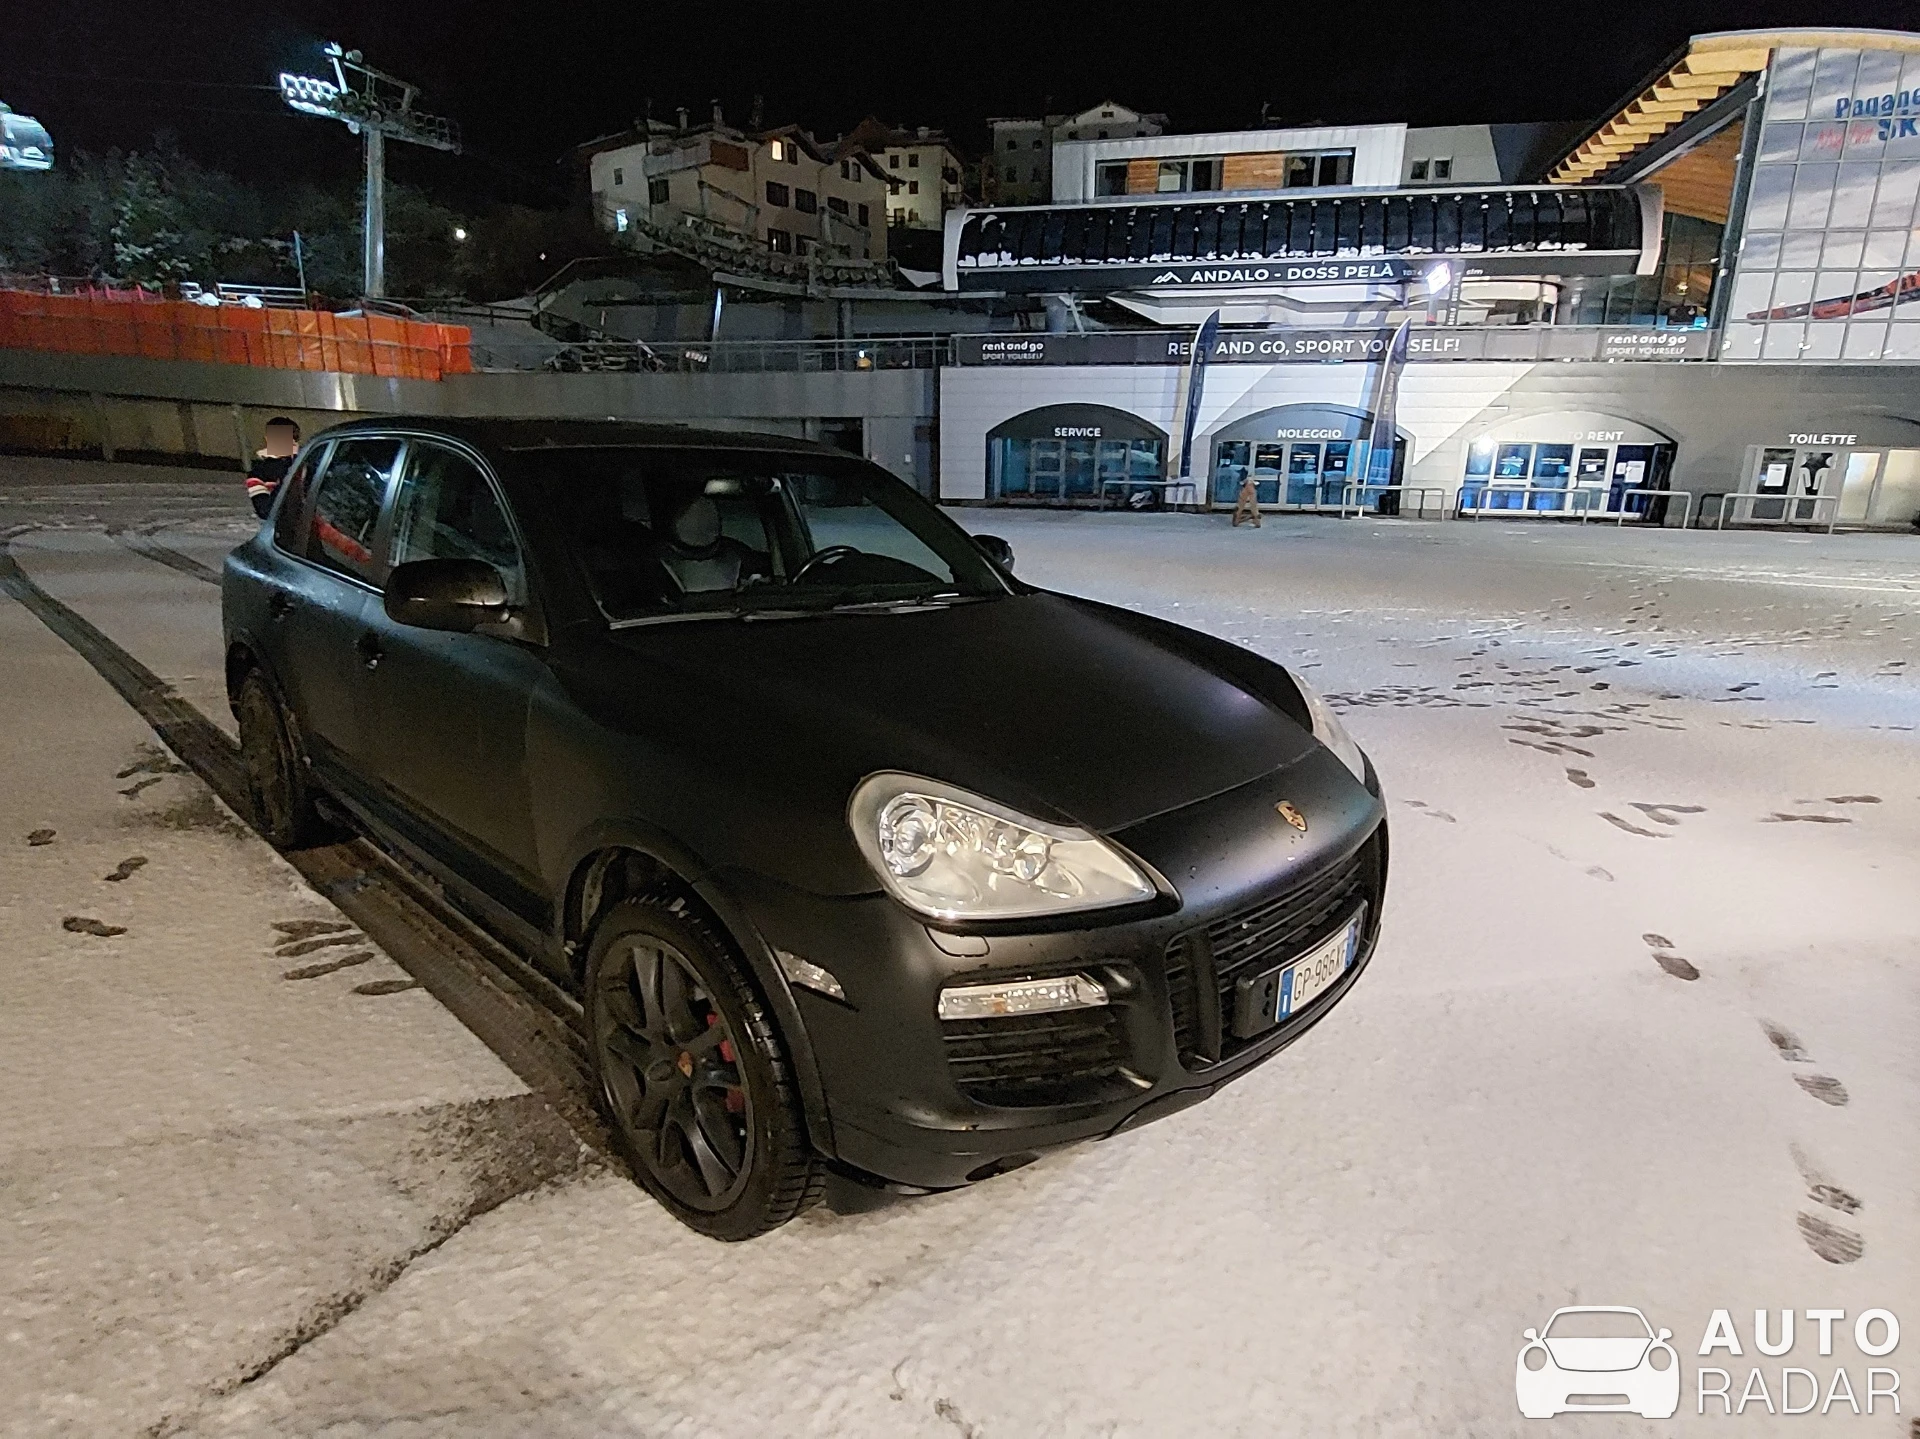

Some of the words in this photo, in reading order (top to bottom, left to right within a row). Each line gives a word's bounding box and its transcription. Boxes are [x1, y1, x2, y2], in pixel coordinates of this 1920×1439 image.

[1190, 268, 1267, 283] ANDALO
[1287, 265, 1339, 281] DOSS
[1344, 262, 1394, 279] PELÀ
[1607, 334, 1638, 344] rent
[1640, 333, 1668, 344] and
[1667, 335, 1687, 346] go
[982, 341, 1005, 350] rent
[1006, 341, 1028, 350] and
[1029, 343, 1044, 352] go
[1215, 341, 1255, 355] AND
[1260, 340, 1289, 357] GO,
[1295, 340, 1354, 354] SPORT
[1606, 347, 1635, 355] SPORT
[1639, 347, 1686, 355] YOURSELF
[1054, 427, 1101, 438] SERVICE
[1277, 428, 1342, 439] NOLEGGIO
[1587, 431, 1625, 442] RENT
[1788, 433, 1858, 445] TOILETTE
